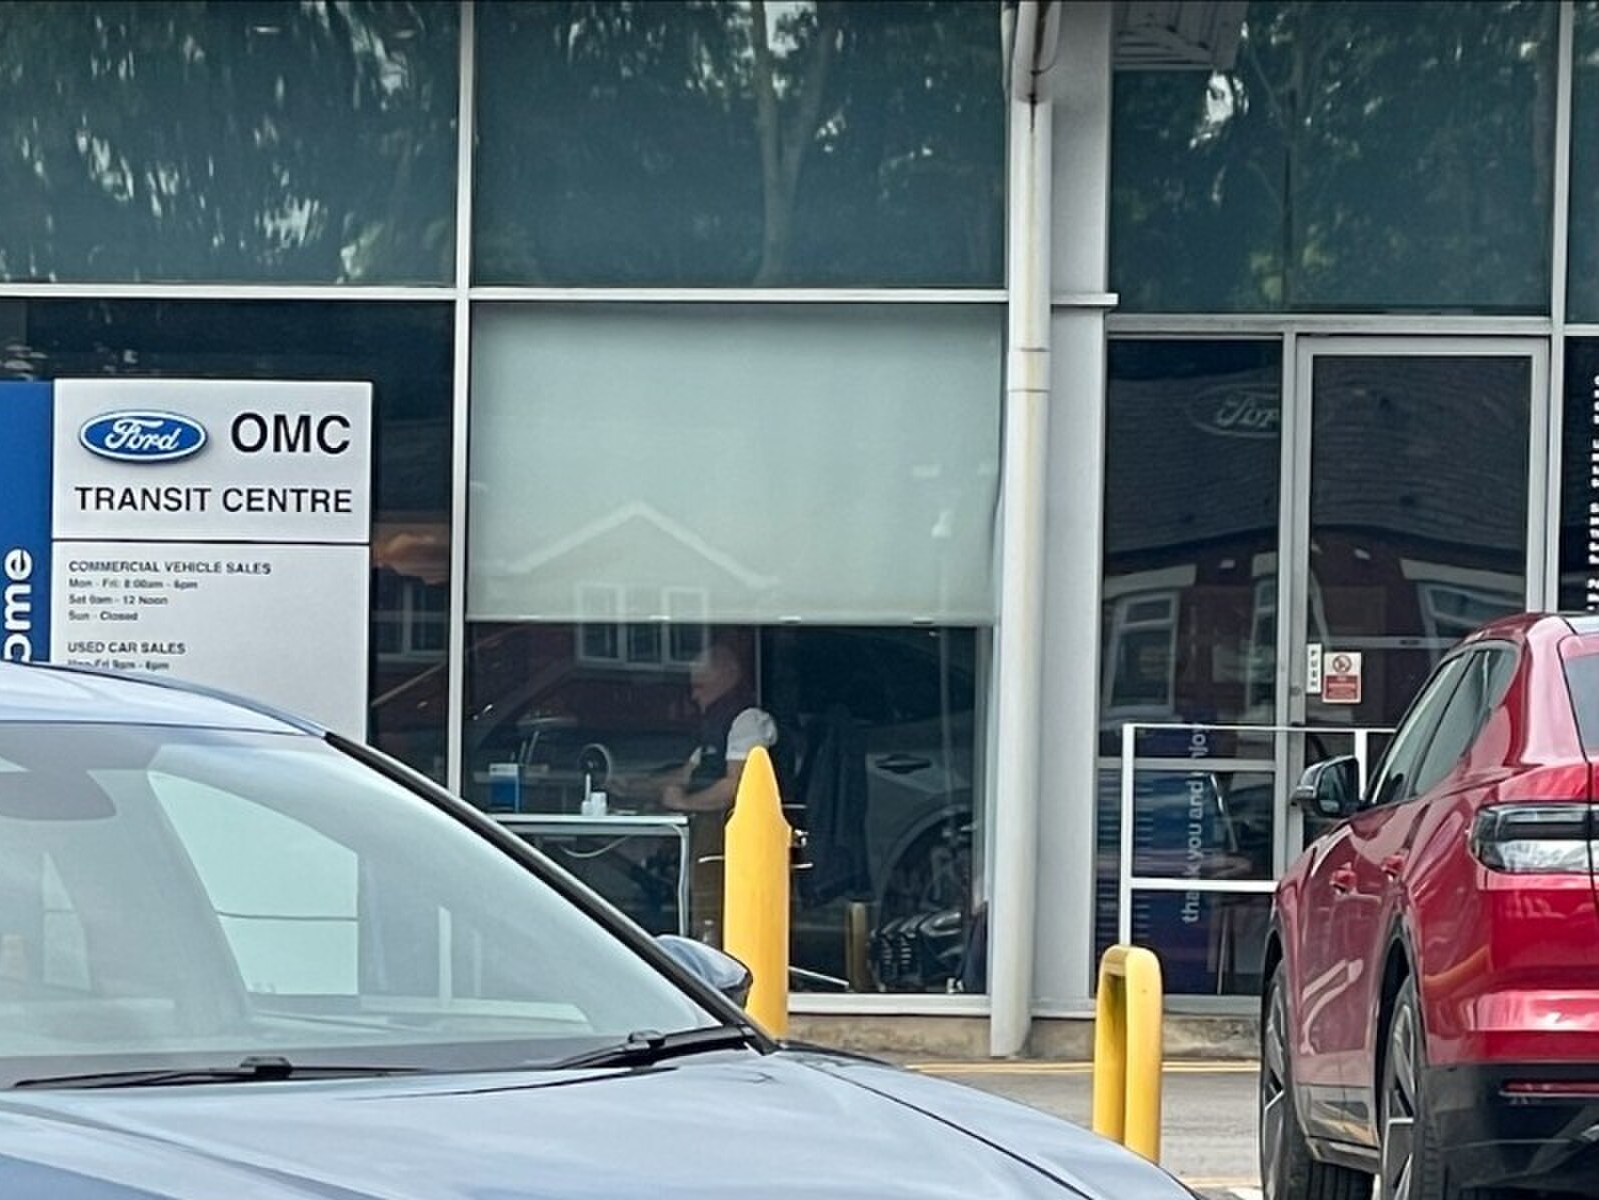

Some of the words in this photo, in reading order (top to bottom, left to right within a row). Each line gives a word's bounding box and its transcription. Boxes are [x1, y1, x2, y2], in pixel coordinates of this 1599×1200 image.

[104, 417, 180, 450] Ford
[230, 411, 351, 455] OMC
[75, 486, 212, 512] TRANSIT
[222, 487, 353, 513] CENTRE
[68, 560, 160, 573] COMMERCIAL
[165, 561, 222, 574] VEHICLE
[226, 562, 272, 576] SALES
[68, 578, 93, 588] Mon
[68, 594, 87, 605] Sat
[123, 595, 135, 604] 12
[138, 596, 168, 605] Noon
[68, 610, 90, 620] Sun
[100, 611, 139, 621] Closed
[67, 641, 105, 654] USED
[108, 642, 138, 654] CAR
[141, 642, 186, 655] SALES
[1185, 779, 1204, 820] and
[1187, 822, 1205, 862] you
[1181, 863, 1201, 924] thak
